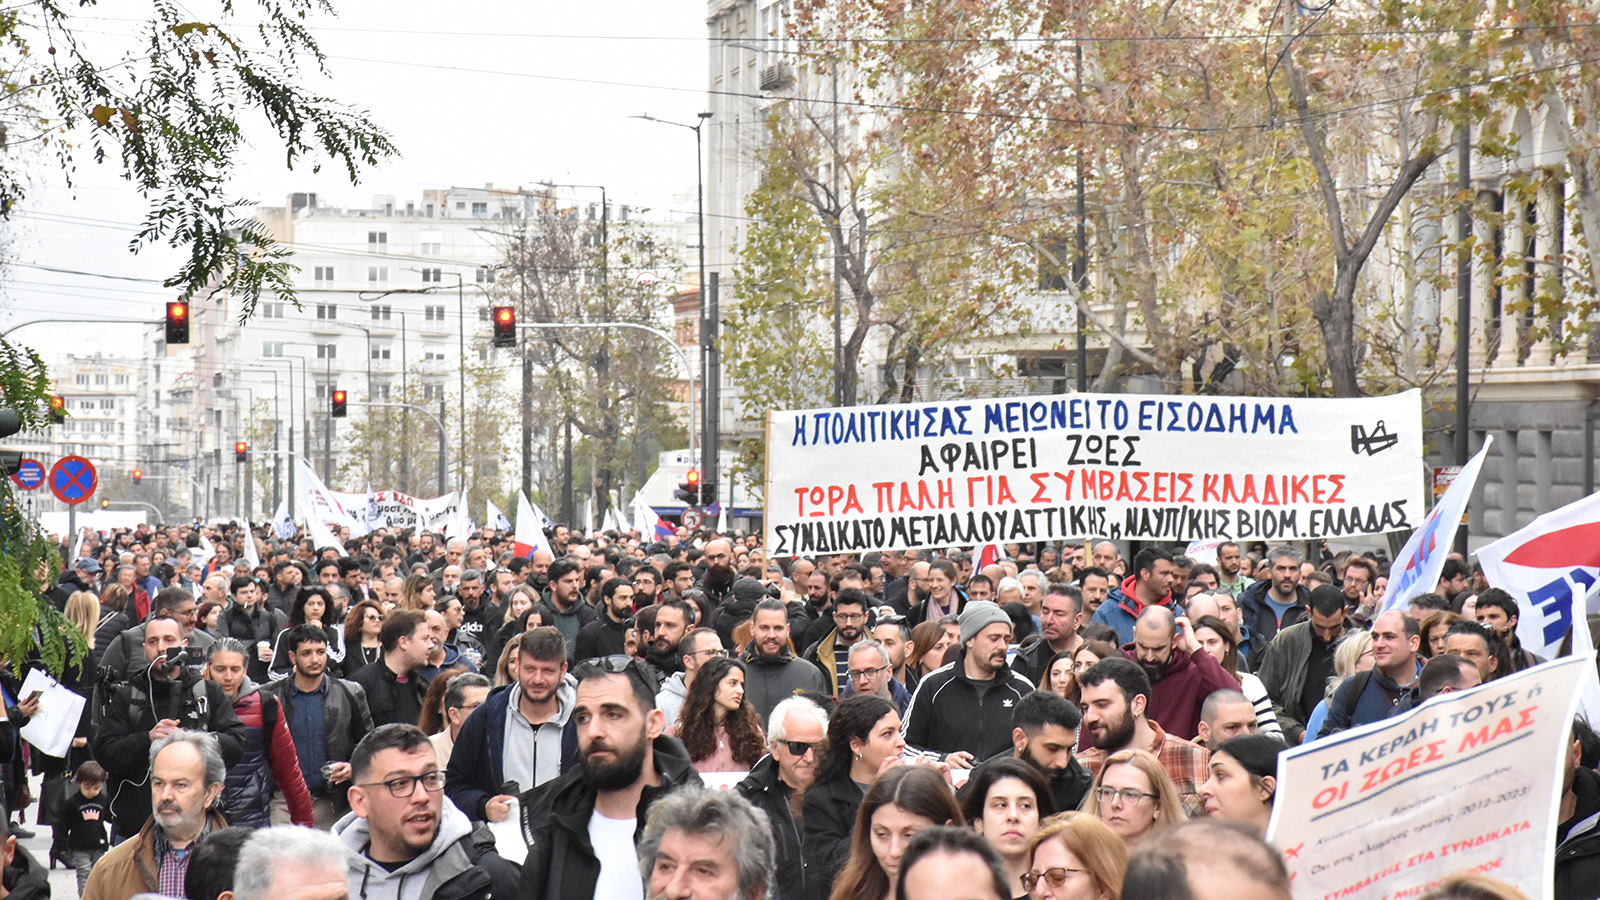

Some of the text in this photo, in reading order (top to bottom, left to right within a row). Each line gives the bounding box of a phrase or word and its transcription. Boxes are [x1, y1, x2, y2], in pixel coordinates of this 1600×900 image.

[792, 414, 806, 446] Η
[1097, 399, 1129, 431] ΤΟ
[1138, 400, 1299, 435] ΕΙΣΟΔΗΜΑ
[918, 434, 1142, 476] ΑΦΑΙΡΕΙ ΖΩΕΣ
[794, 468, 1346, 517] ΤΩΡΑ ΠΑΛΗ ΓΙΑ ΣΥΜΒΑΣΕΙΣ ΚΛΑΔΙΚΕΣ
[1309, 499, 1412, 538] ΕΛΛΑΔΑΣ
[1312, 705, 1539, 809] ΟΙ ΖΩΕΣ ΜΑΣ
[1321, 758, 1349, 780] ΤΑ
[1359, 718, 1439, 766] ΚΕΡΔΗ
[1449, 690, 1518, 729] ΤΟΥΣ
